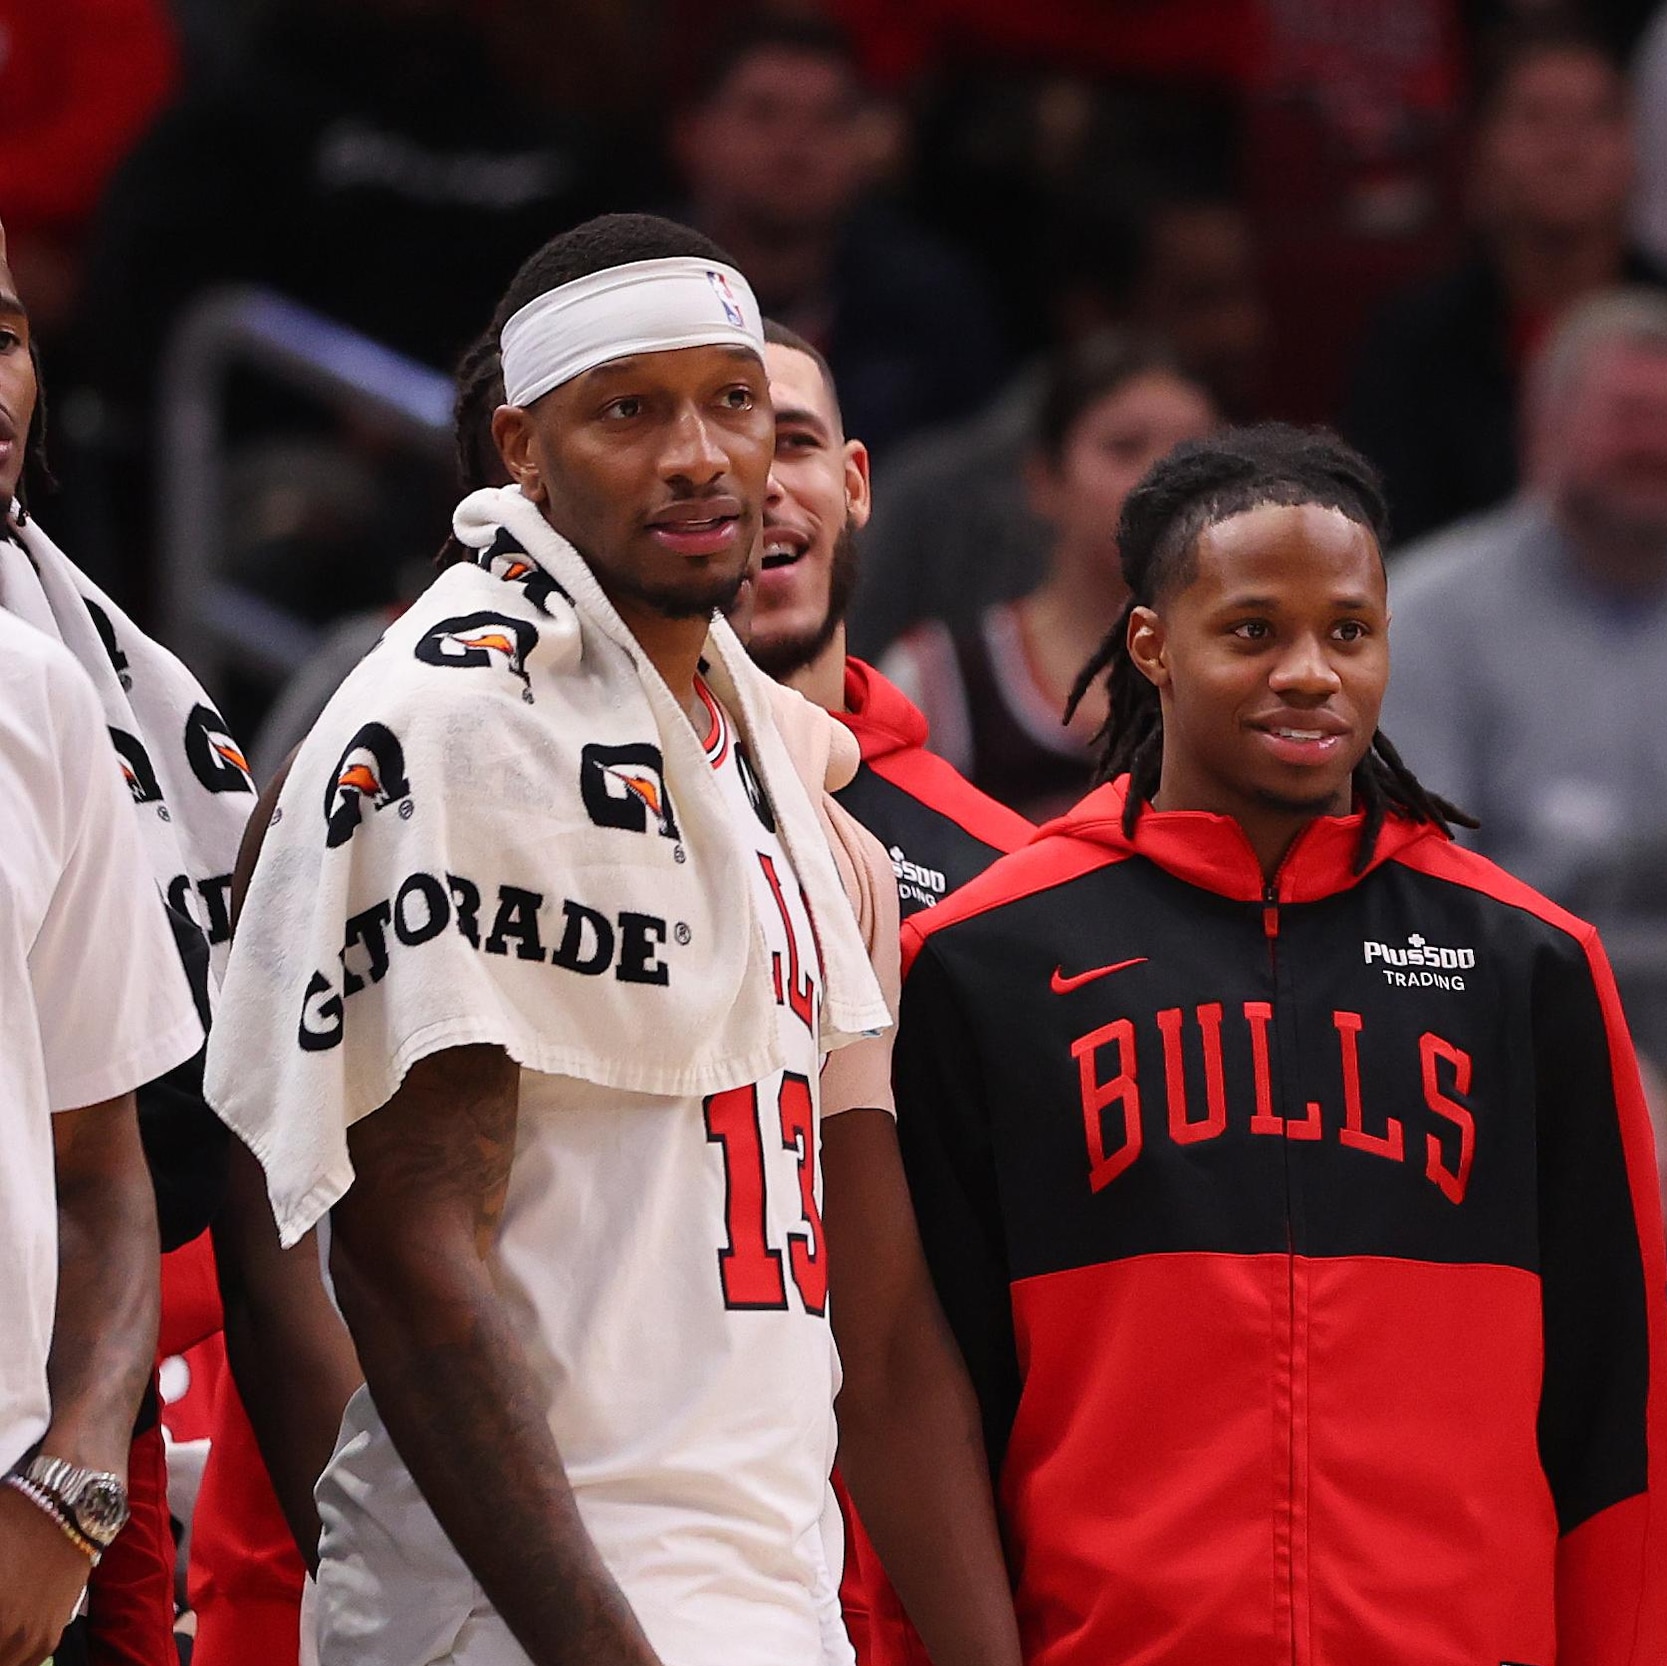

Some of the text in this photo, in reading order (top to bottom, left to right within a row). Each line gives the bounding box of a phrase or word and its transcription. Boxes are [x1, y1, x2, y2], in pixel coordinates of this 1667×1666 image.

[1364, 938, 1475, 969] Plus500
[1383, 970, 1465, 990] TRADING
[1071, 1002, 1476, 1206] BULLS
[705, 1072, 829, 1317] 13
